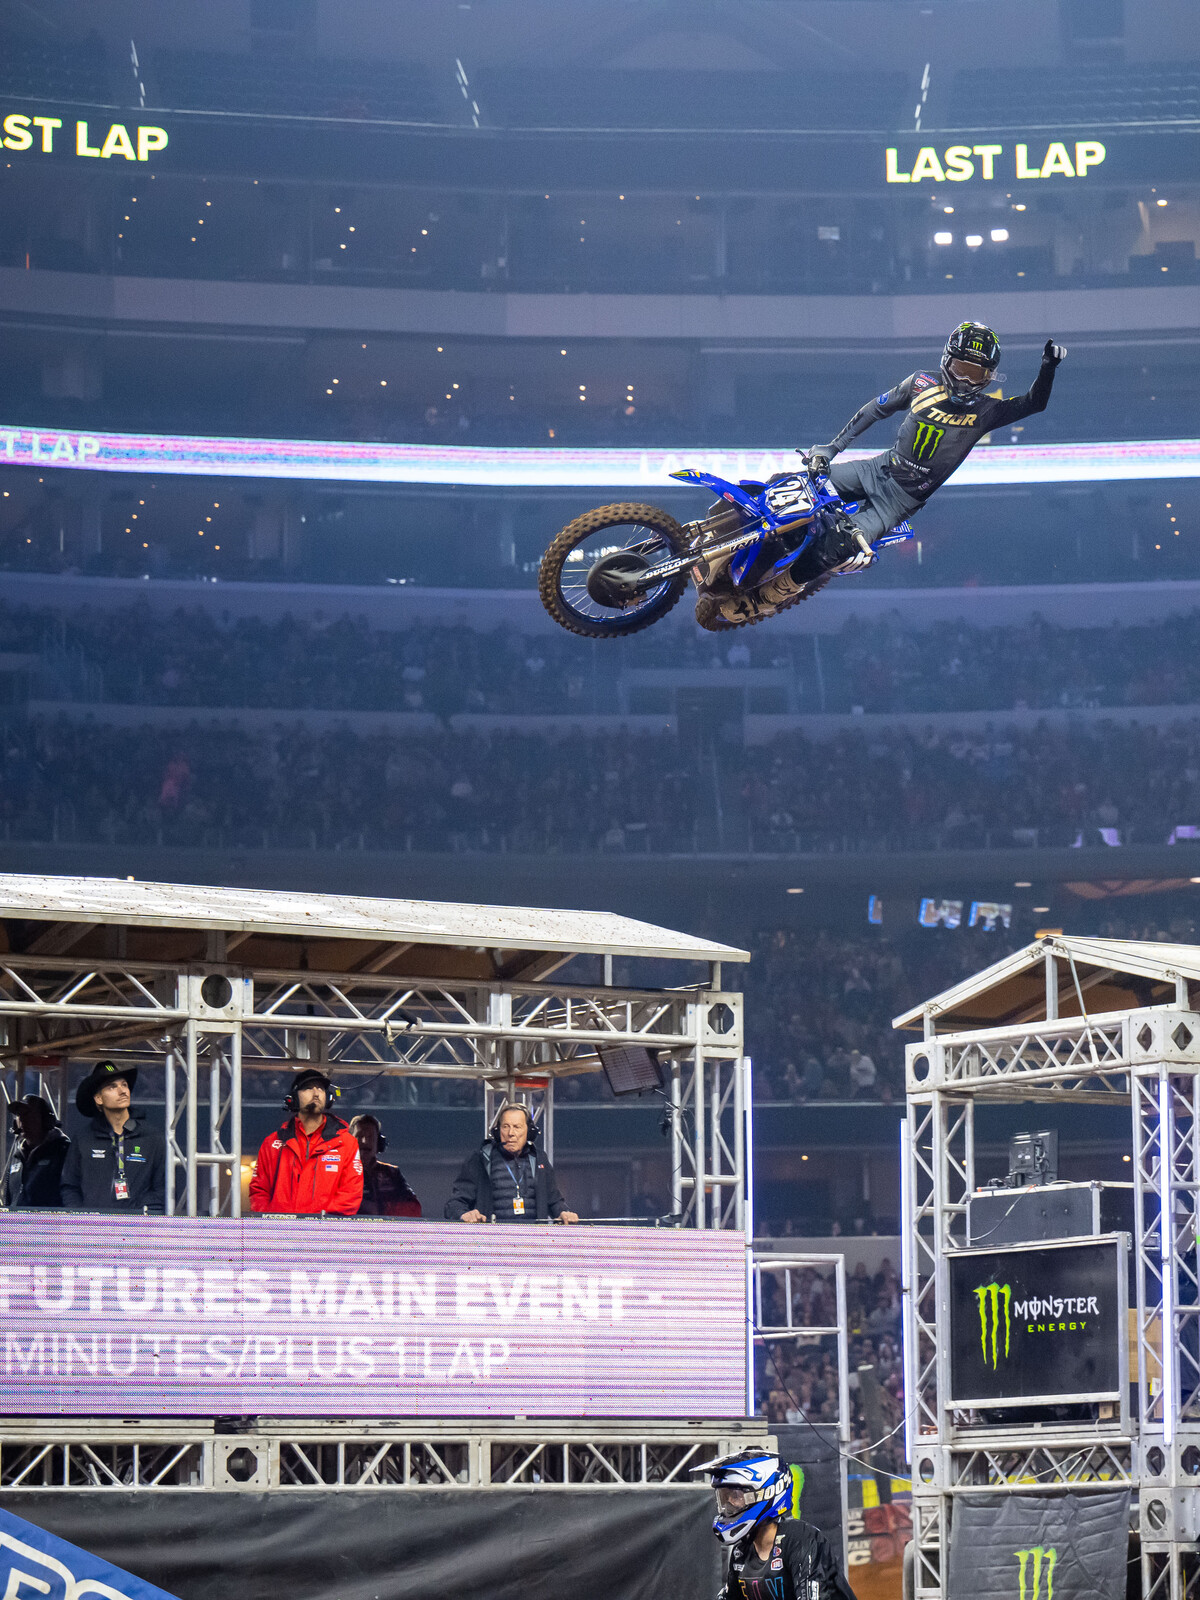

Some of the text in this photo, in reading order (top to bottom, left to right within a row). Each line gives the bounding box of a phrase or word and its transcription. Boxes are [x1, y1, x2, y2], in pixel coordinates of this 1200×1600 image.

[0, 114, 169, 161] ST LAP
[886, 141, 1106, 183] LAST LAP
[926, 407, 978, 427] THOR
[32, 433, 100, 462] LAP
[768, 479, 812, 518] 241
[645, 558, 690, 579] DUNLOP
[0, 1264, 272, 1315] FUTURES
[290, 1268, 436, 1317] MAIN
[456, 1273, 634, 1321] EVENT
[1014, 1295, 1100, 1321] MONSTER
[1027, 1321, 1087, 1333] ENERGY
[5, 1332, 374, 1379] MINUTES/PLUS
[424, 1338, 511, 1379] LAP
[754, 1472, 792, 1503] 100%
